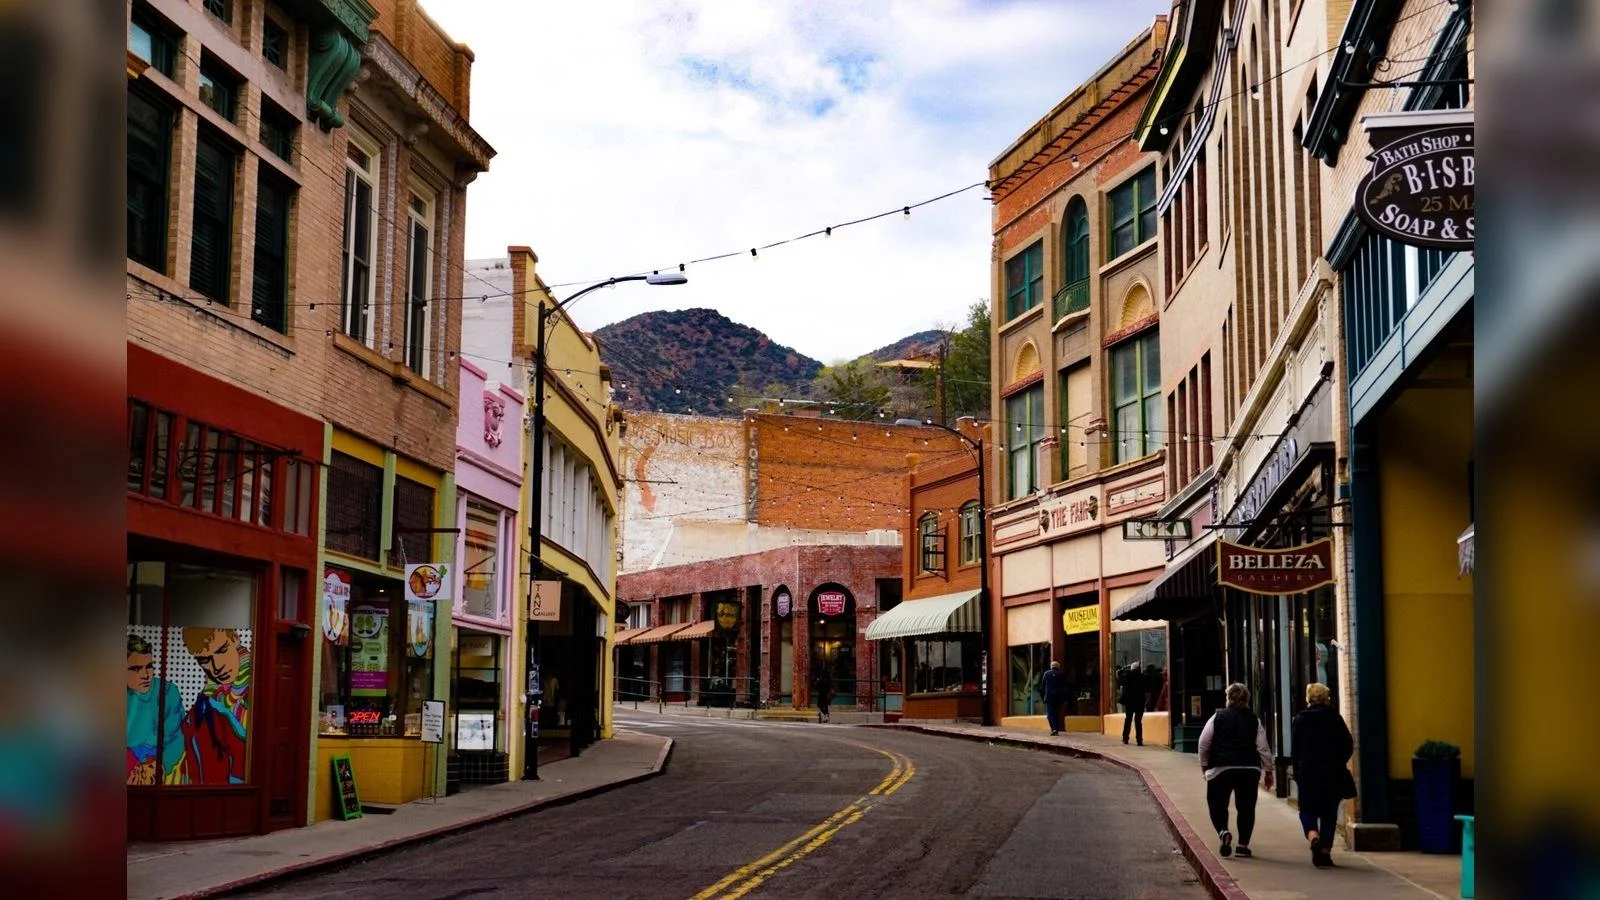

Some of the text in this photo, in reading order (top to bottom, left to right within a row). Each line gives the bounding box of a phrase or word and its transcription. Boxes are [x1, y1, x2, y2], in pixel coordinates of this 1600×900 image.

[1381, 135, 1460, 167] BATH SHOP
[1420, 196, 1443, 213] 25
[1379, 204, 1436, 237] SOAP
[1441, 218, 1460, 239] &
[699, 431, 737, 449] BOX
[1050, 505, 1067, 530] THE
[1228, 554, 1326, 570] BELLEZA
[1237, 574, 1314, 582] GALLERY
[1068, 608, 1098, 623] MUSEUM
[350, 711, 381, 721] OPEN
